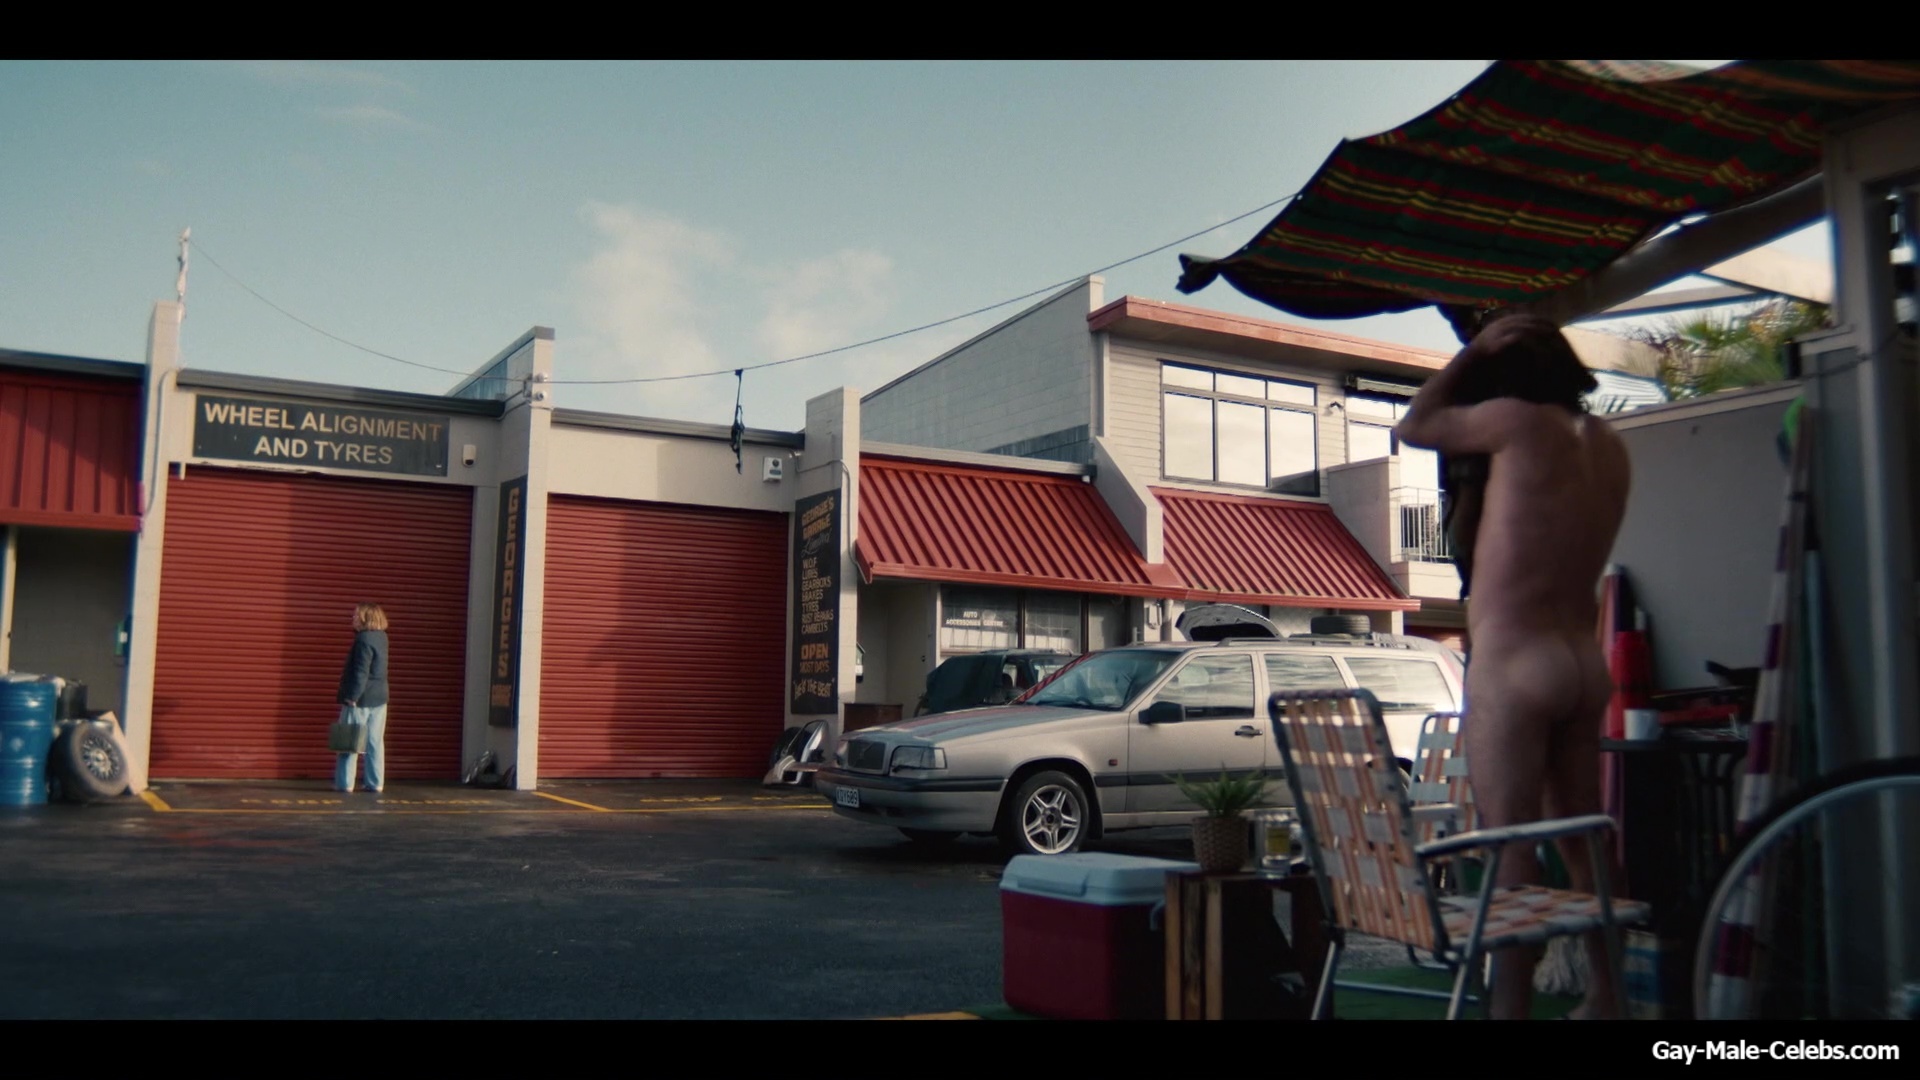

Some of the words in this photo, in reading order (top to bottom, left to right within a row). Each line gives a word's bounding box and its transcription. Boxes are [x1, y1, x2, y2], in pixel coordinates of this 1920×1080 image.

[204, 402, 296, 430] WHEEL
[300, 411, 442, 442] ALIGNMENT
[253, 435, 308, 458] AND
[313, 440, 393, 465] TYRES
[801, 643, 829, 660] OPEN
